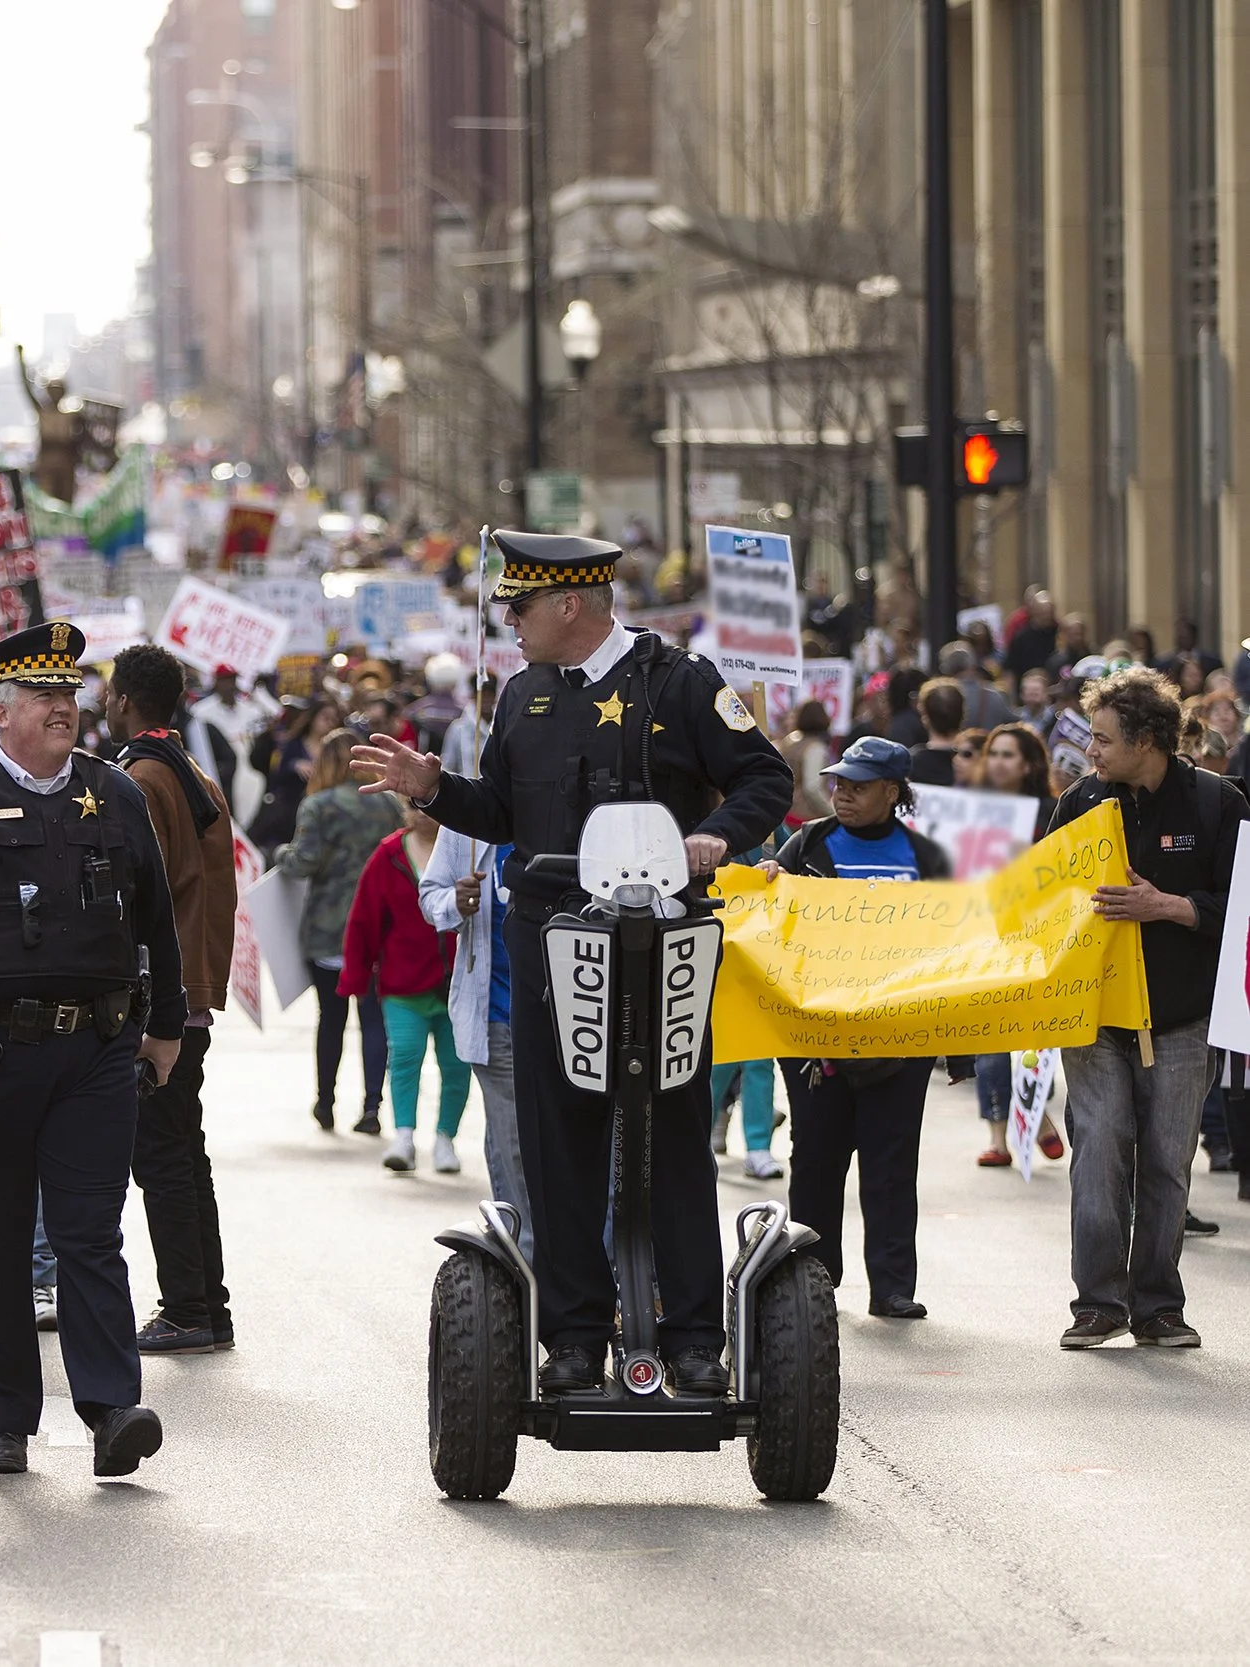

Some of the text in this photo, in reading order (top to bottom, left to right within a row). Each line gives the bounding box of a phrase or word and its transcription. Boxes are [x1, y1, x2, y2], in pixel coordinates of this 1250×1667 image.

[1034, 838, 1113, 892] Diego
[756, 930, 853, 962] Creando
[1053, 897, 1100, 926] socia
[571, 938, 605, 1081] POLICE
[665, 935, 696, 1079] POLICE
[758, 995, 838, 1026] Creating
[968, 982, 1034, 1007] social
[1042, 962, 1118, 999] chane,
[789, 1008, 1091, 1047] while serving those in need.
